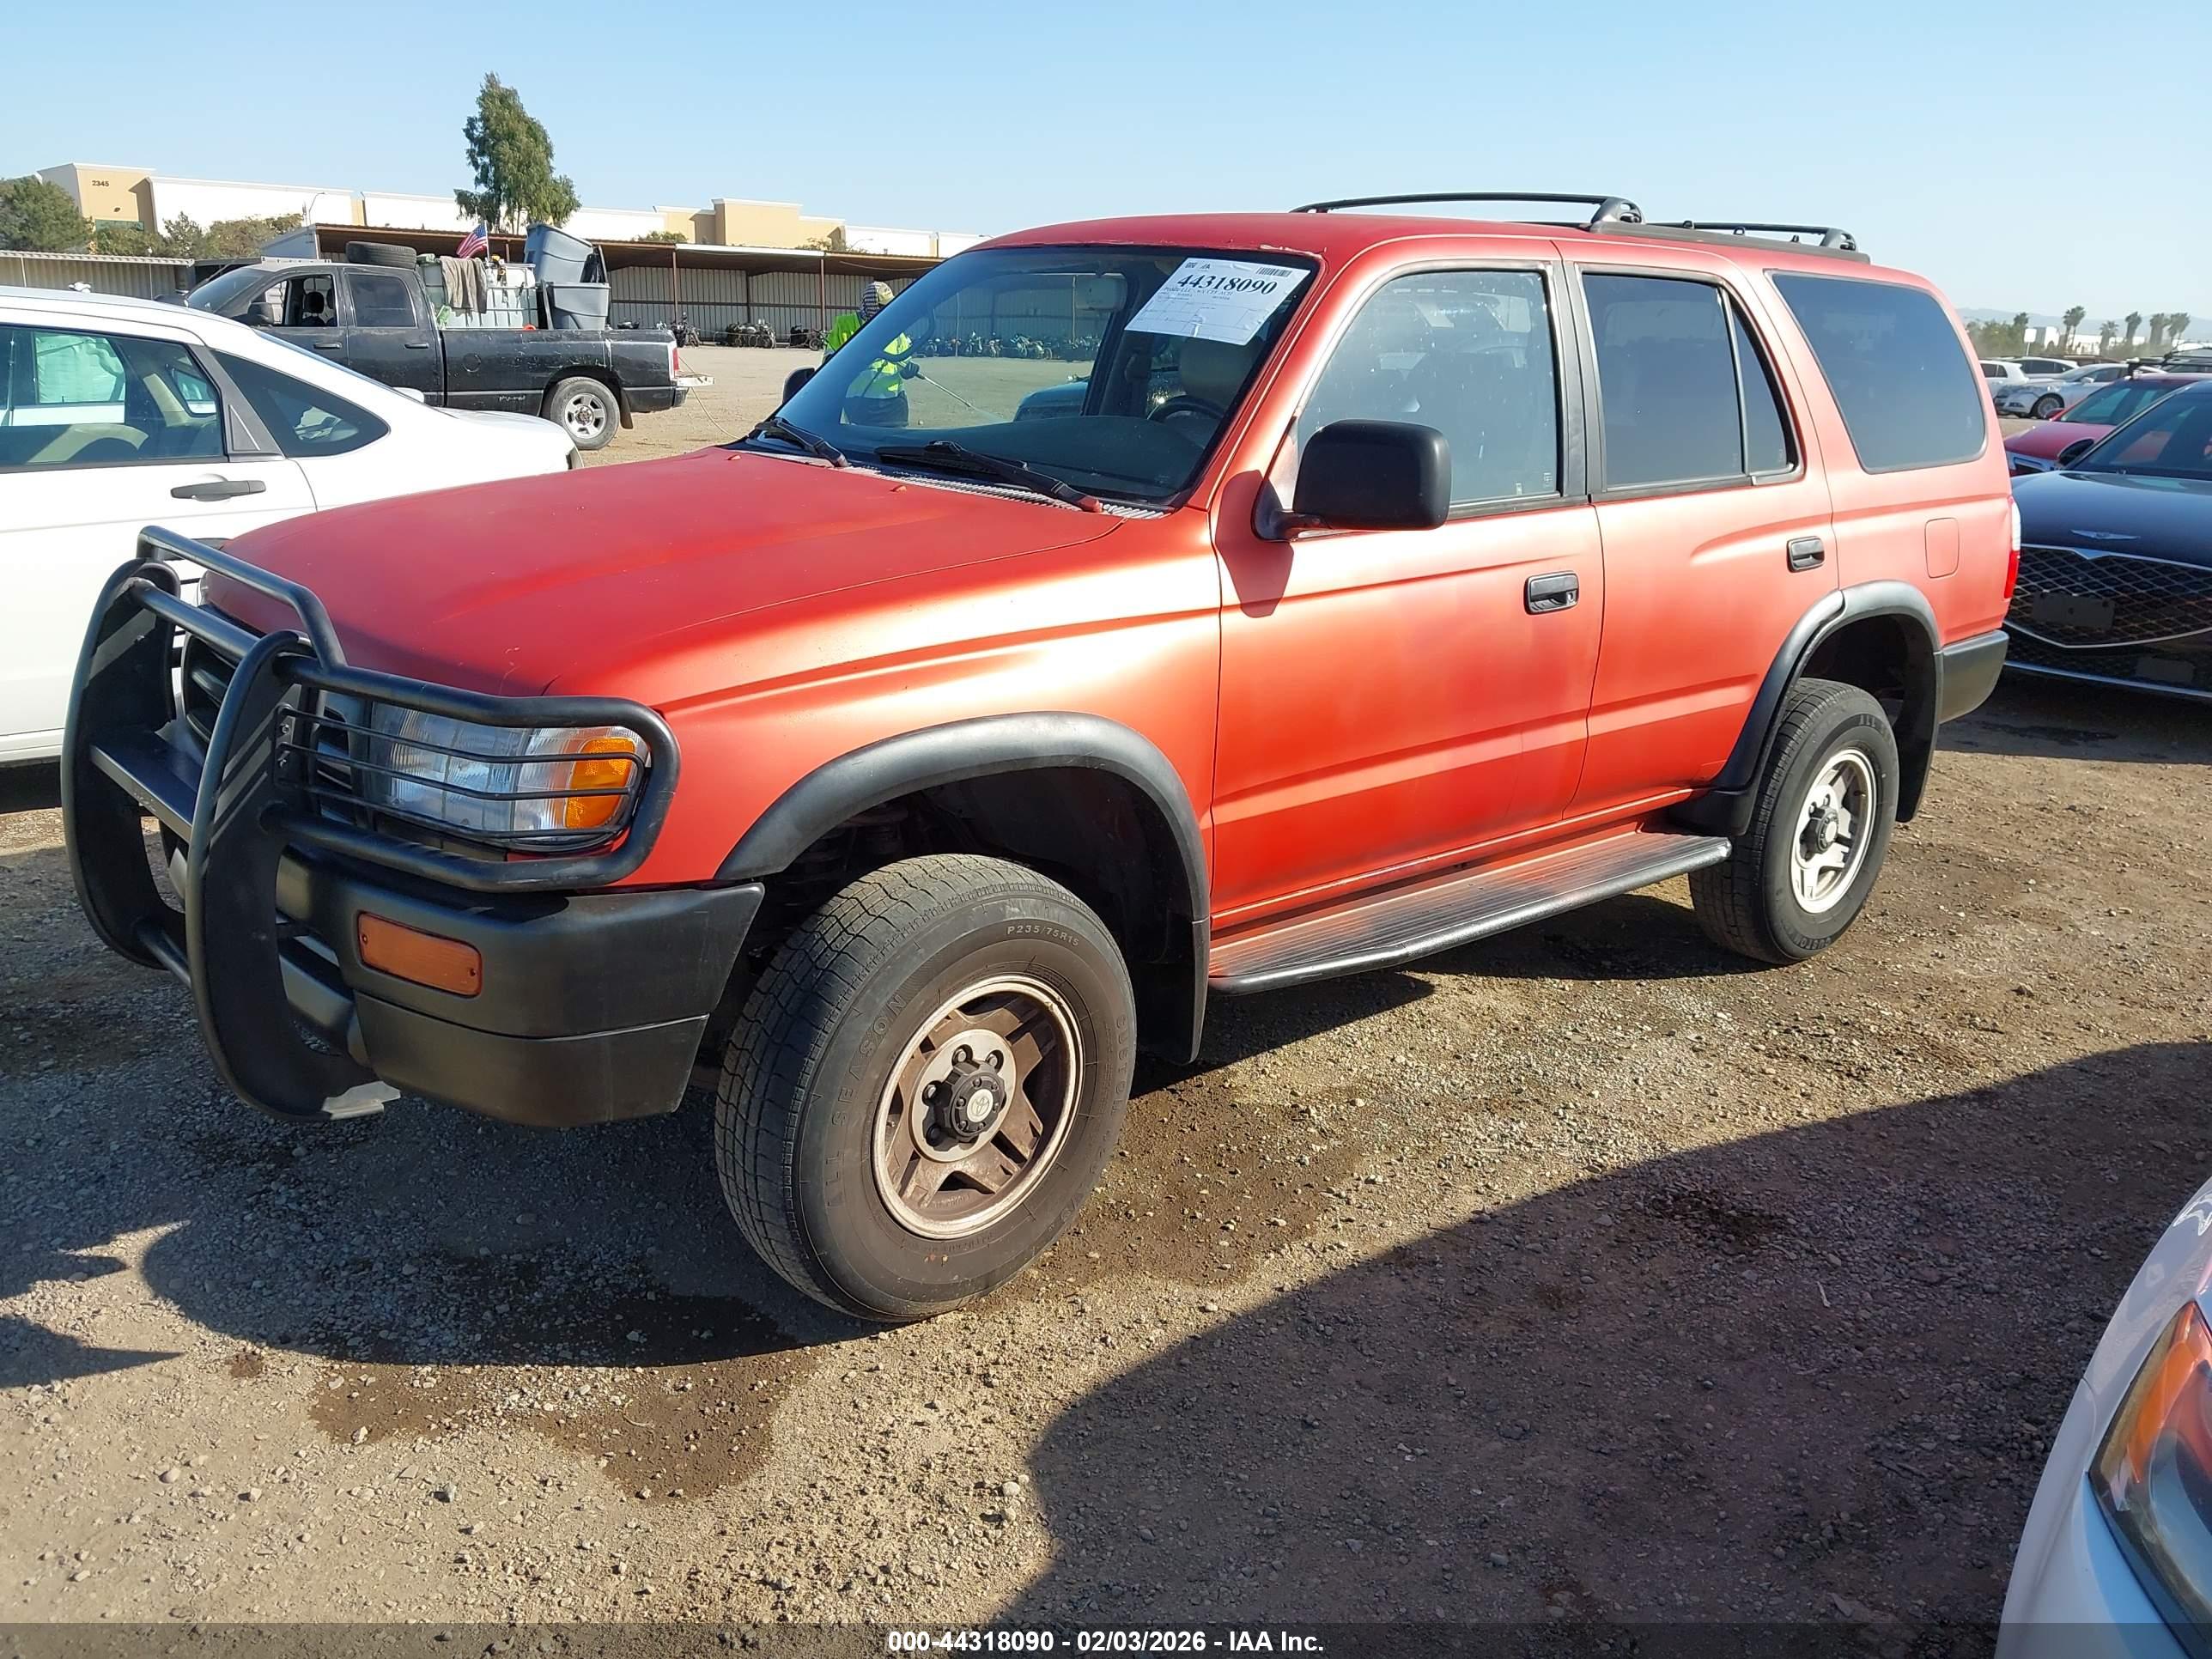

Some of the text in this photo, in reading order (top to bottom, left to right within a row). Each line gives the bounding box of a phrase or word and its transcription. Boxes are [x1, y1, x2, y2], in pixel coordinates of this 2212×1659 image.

[1176, 274, 1278, 295] 44318090
[1006, 925, 1079, 947] P235/75R15
[831, 994, 908, 1127] SEASON
